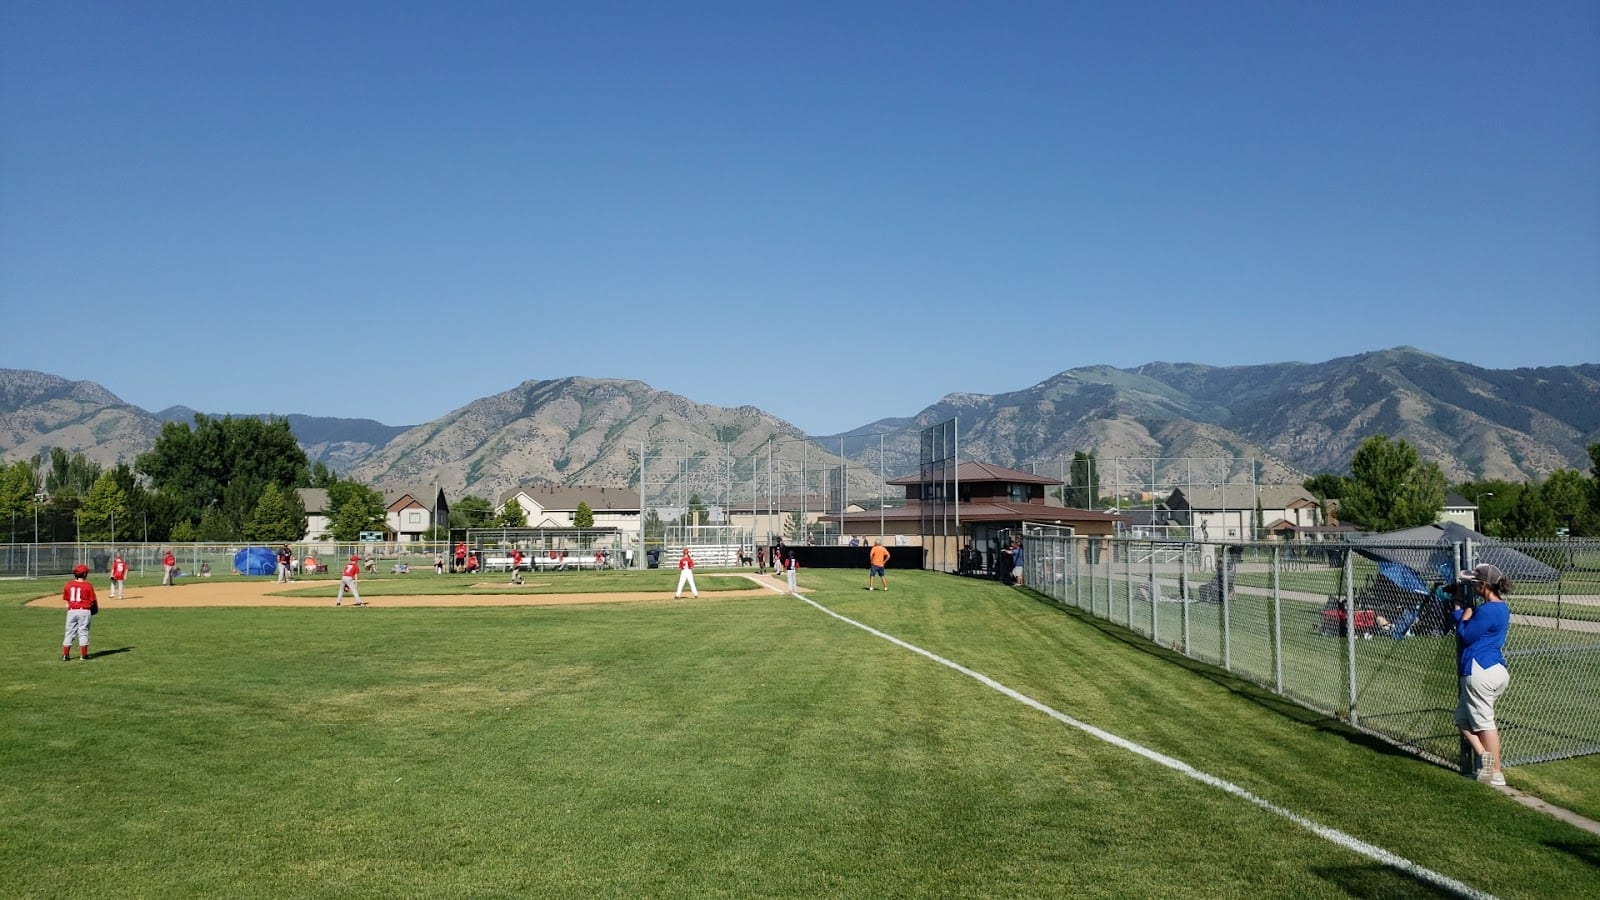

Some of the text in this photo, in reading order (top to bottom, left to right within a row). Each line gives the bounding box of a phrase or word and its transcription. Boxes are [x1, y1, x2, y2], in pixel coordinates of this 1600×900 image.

[117, 563, 123, 571] 5
[346, 564, 353, 572] 7
[70, 587, 81, 602] 11
